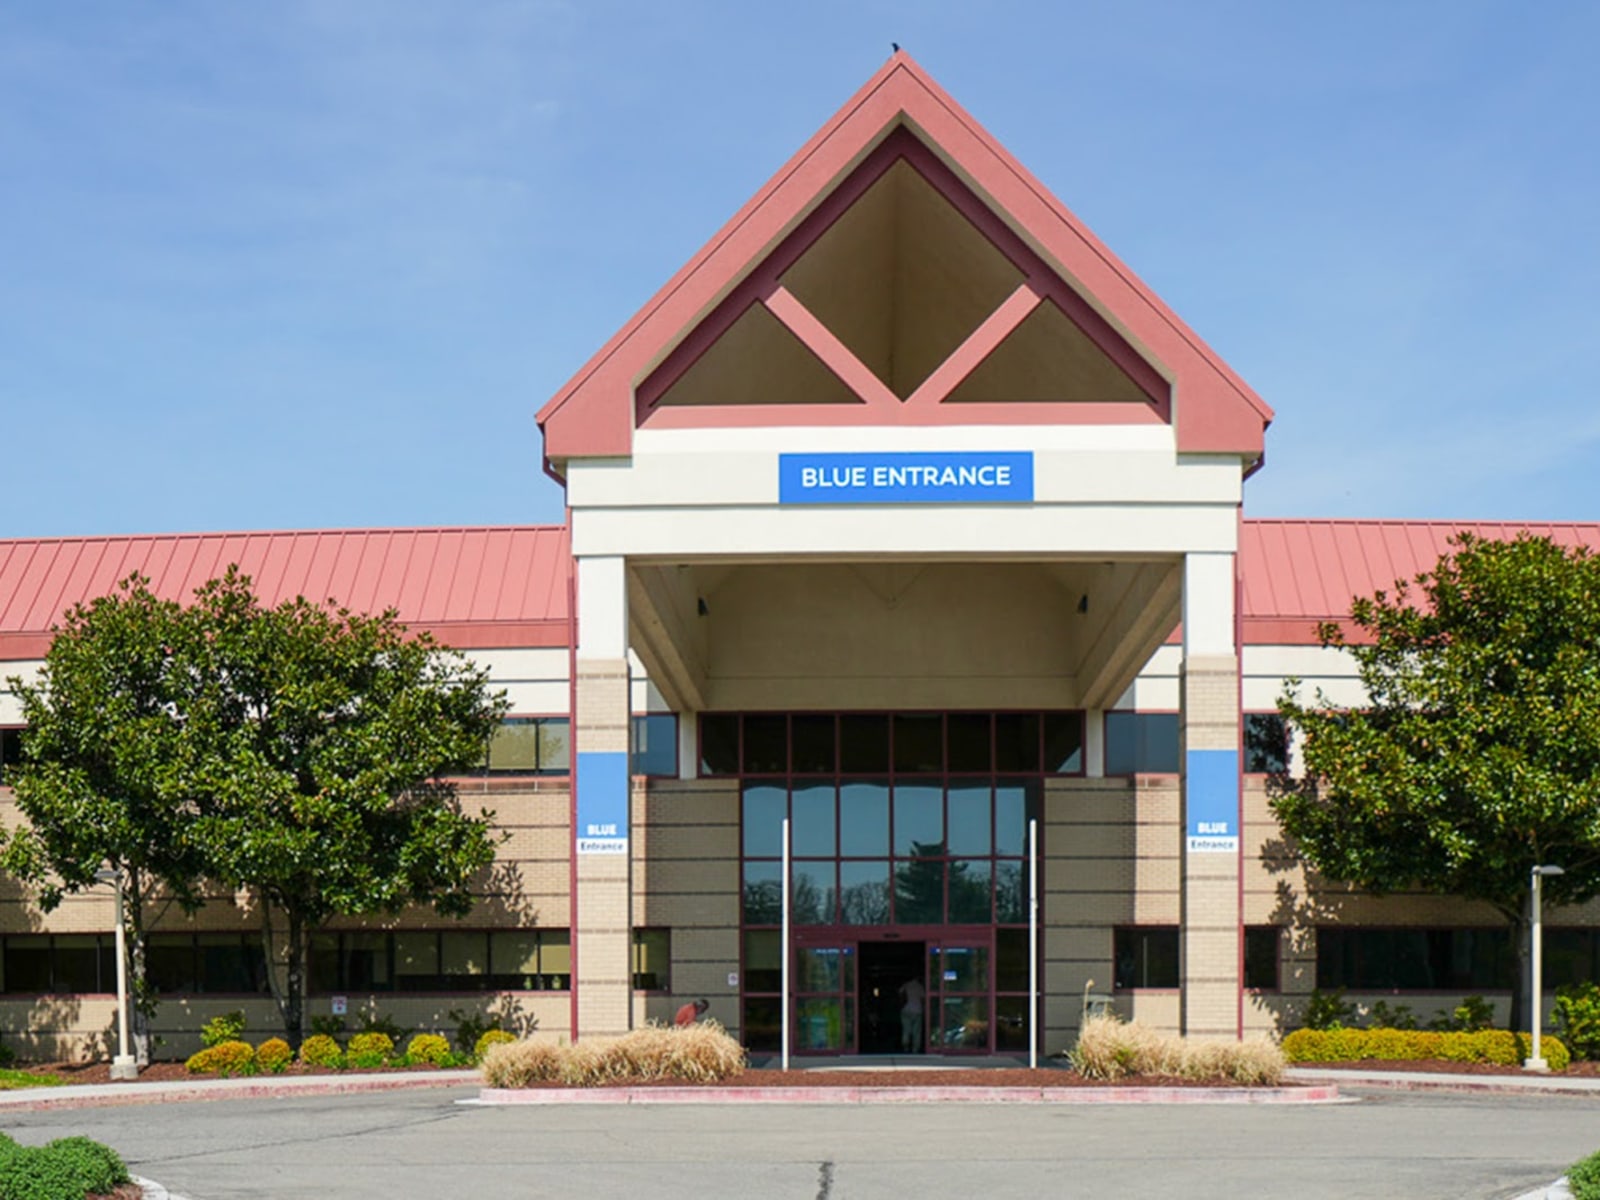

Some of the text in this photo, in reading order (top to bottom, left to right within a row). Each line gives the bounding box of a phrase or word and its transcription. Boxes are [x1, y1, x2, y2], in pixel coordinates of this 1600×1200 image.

[801, 465, 1011, 488] BLUE ENTRANCE
[587, 824, 617, 836] BLUE
[1197, 822, 1228, 834] BLUE
[580, 842, 624, 851] Entrance
[1190, 839, 1234, 849] Entrance
